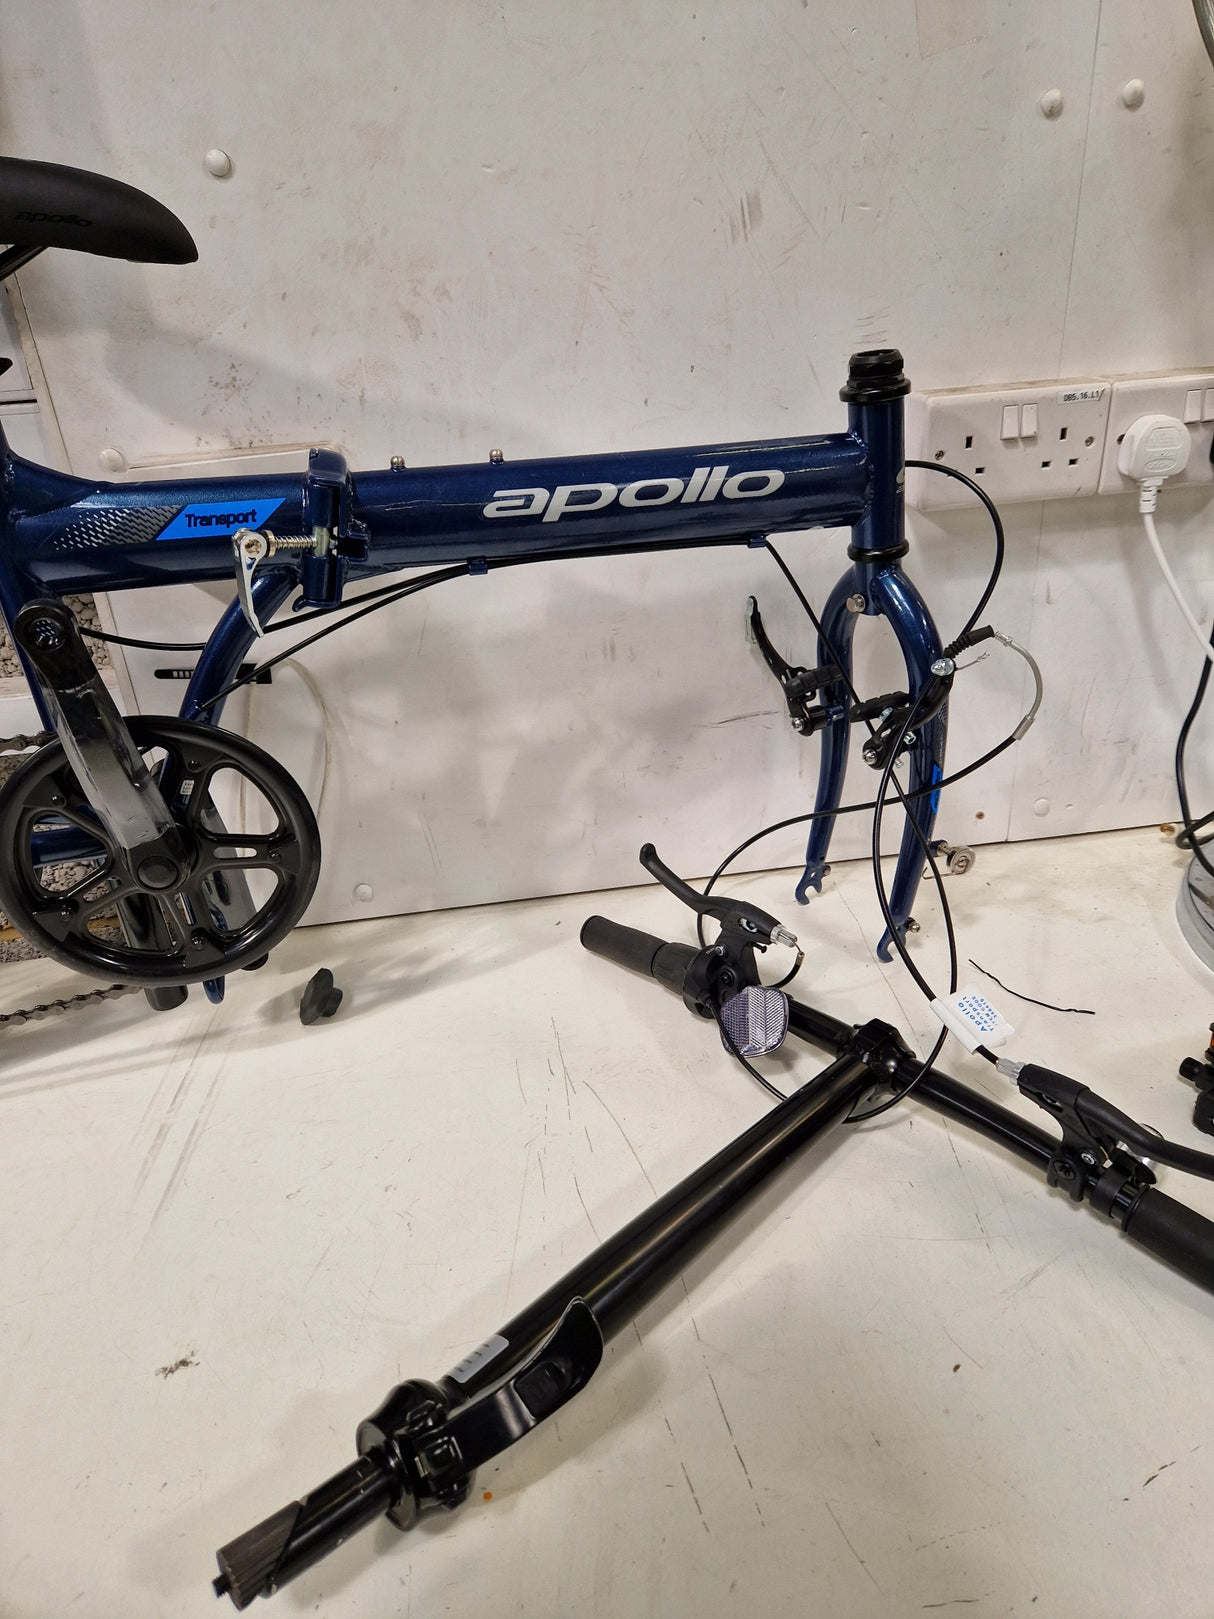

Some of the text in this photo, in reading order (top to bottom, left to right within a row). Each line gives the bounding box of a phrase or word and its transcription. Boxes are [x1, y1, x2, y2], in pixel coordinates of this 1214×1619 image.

[15, 211, 93, 227] apollo
[482, 465, 786, 523] apollo
[185, 508, 257, 528] Transport
[958, 1002, 988, 1031] Apollo
